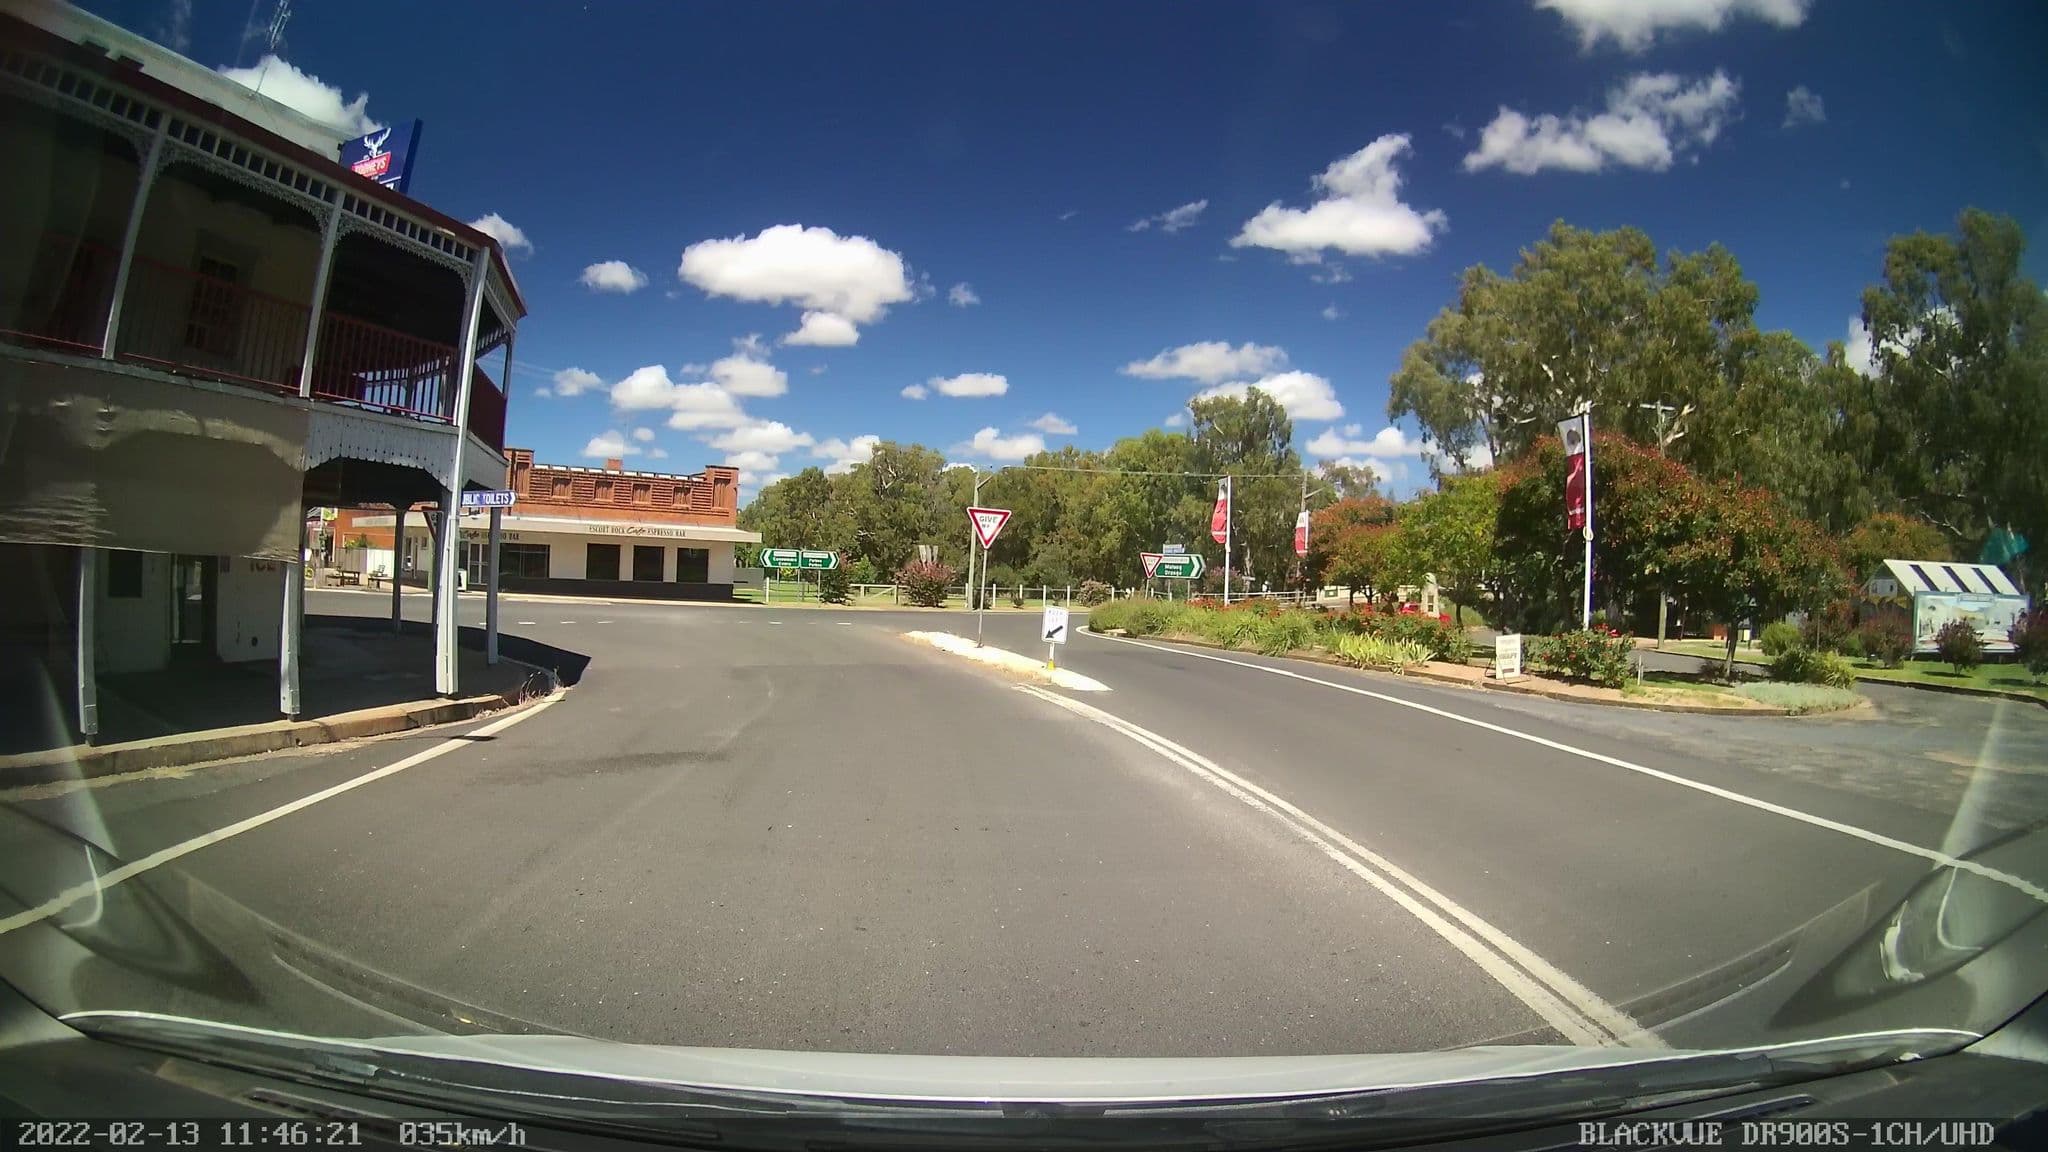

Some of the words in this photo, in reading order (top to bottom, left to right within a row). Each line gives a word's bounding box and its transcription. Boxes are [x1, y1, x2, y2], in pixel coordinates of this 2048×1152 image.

[462, 493, 480, 505] UBLIC
[483, 493, 509, 505] TOILETS
[979, 515, 999, 523] GIVE
[589, 524, 609, 533] ESCORT
[611, 525, 625, 534] ROCK
[647, 528, 674, 537] ESPRESSO
[675, 529, 686, 537] BAR
